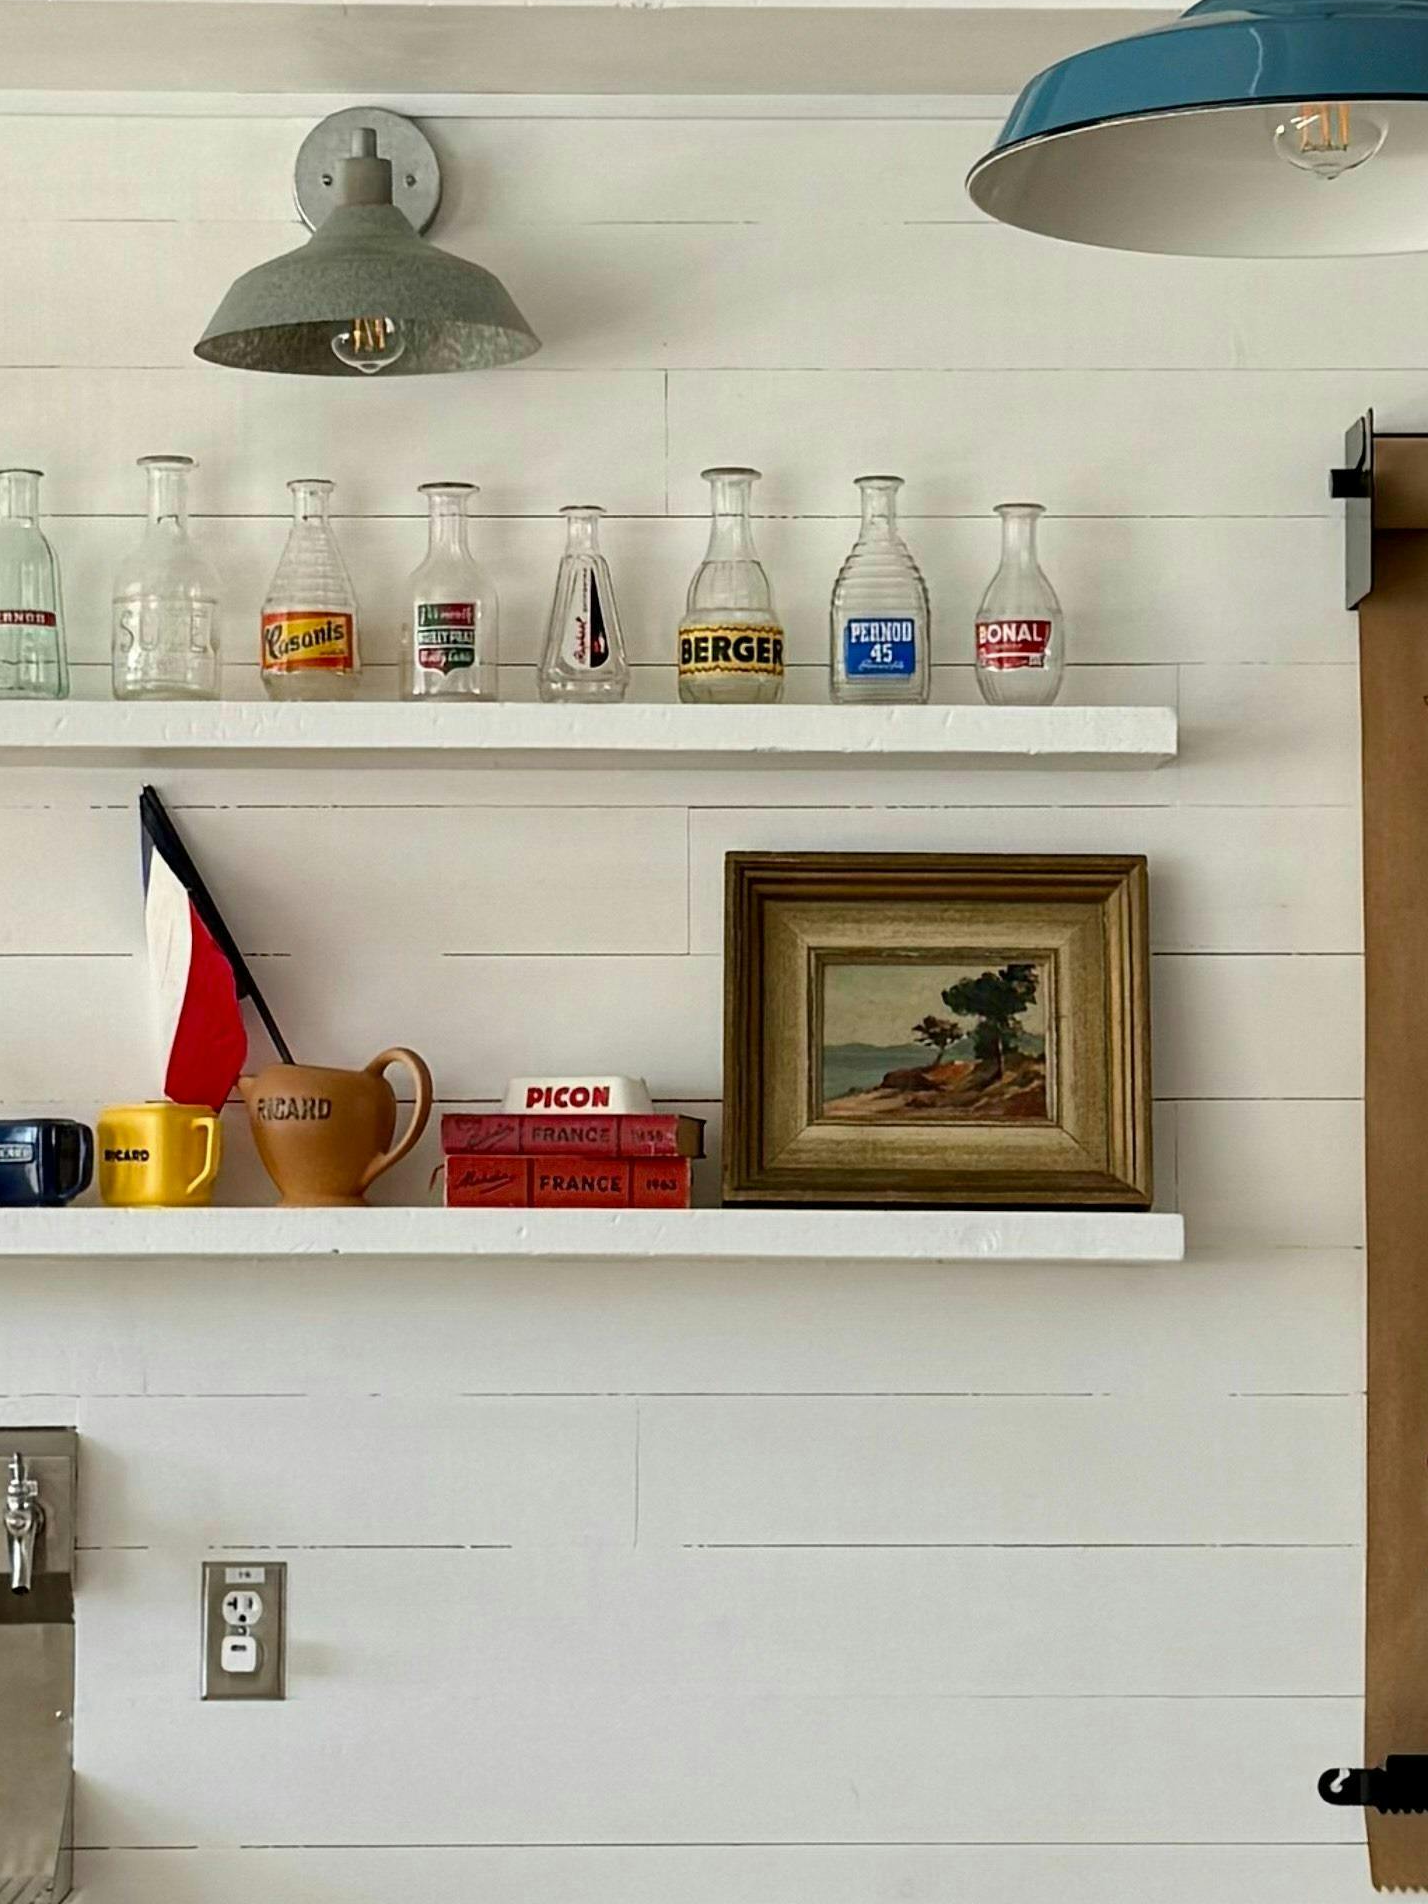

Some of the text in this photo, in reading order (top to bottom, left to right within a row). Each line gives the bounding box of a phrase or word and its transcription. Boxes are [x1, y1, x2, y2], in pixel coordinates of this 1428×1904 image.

[265, 619, 345, 660] Casanis
[850, 621, 913, 643] PERNOD
[978, 622, 1044, 643] BONAL
[680, 635, 783, 665] BERGER
[869, 643, 894, 663] 45
[525, 1085, 611, 1109] PICON
[257, 1096, 332, 1121] RICARD
[531, 1124, 612, 1144] FRANCE
[539, 1173, 623, 1194] FRANCE
